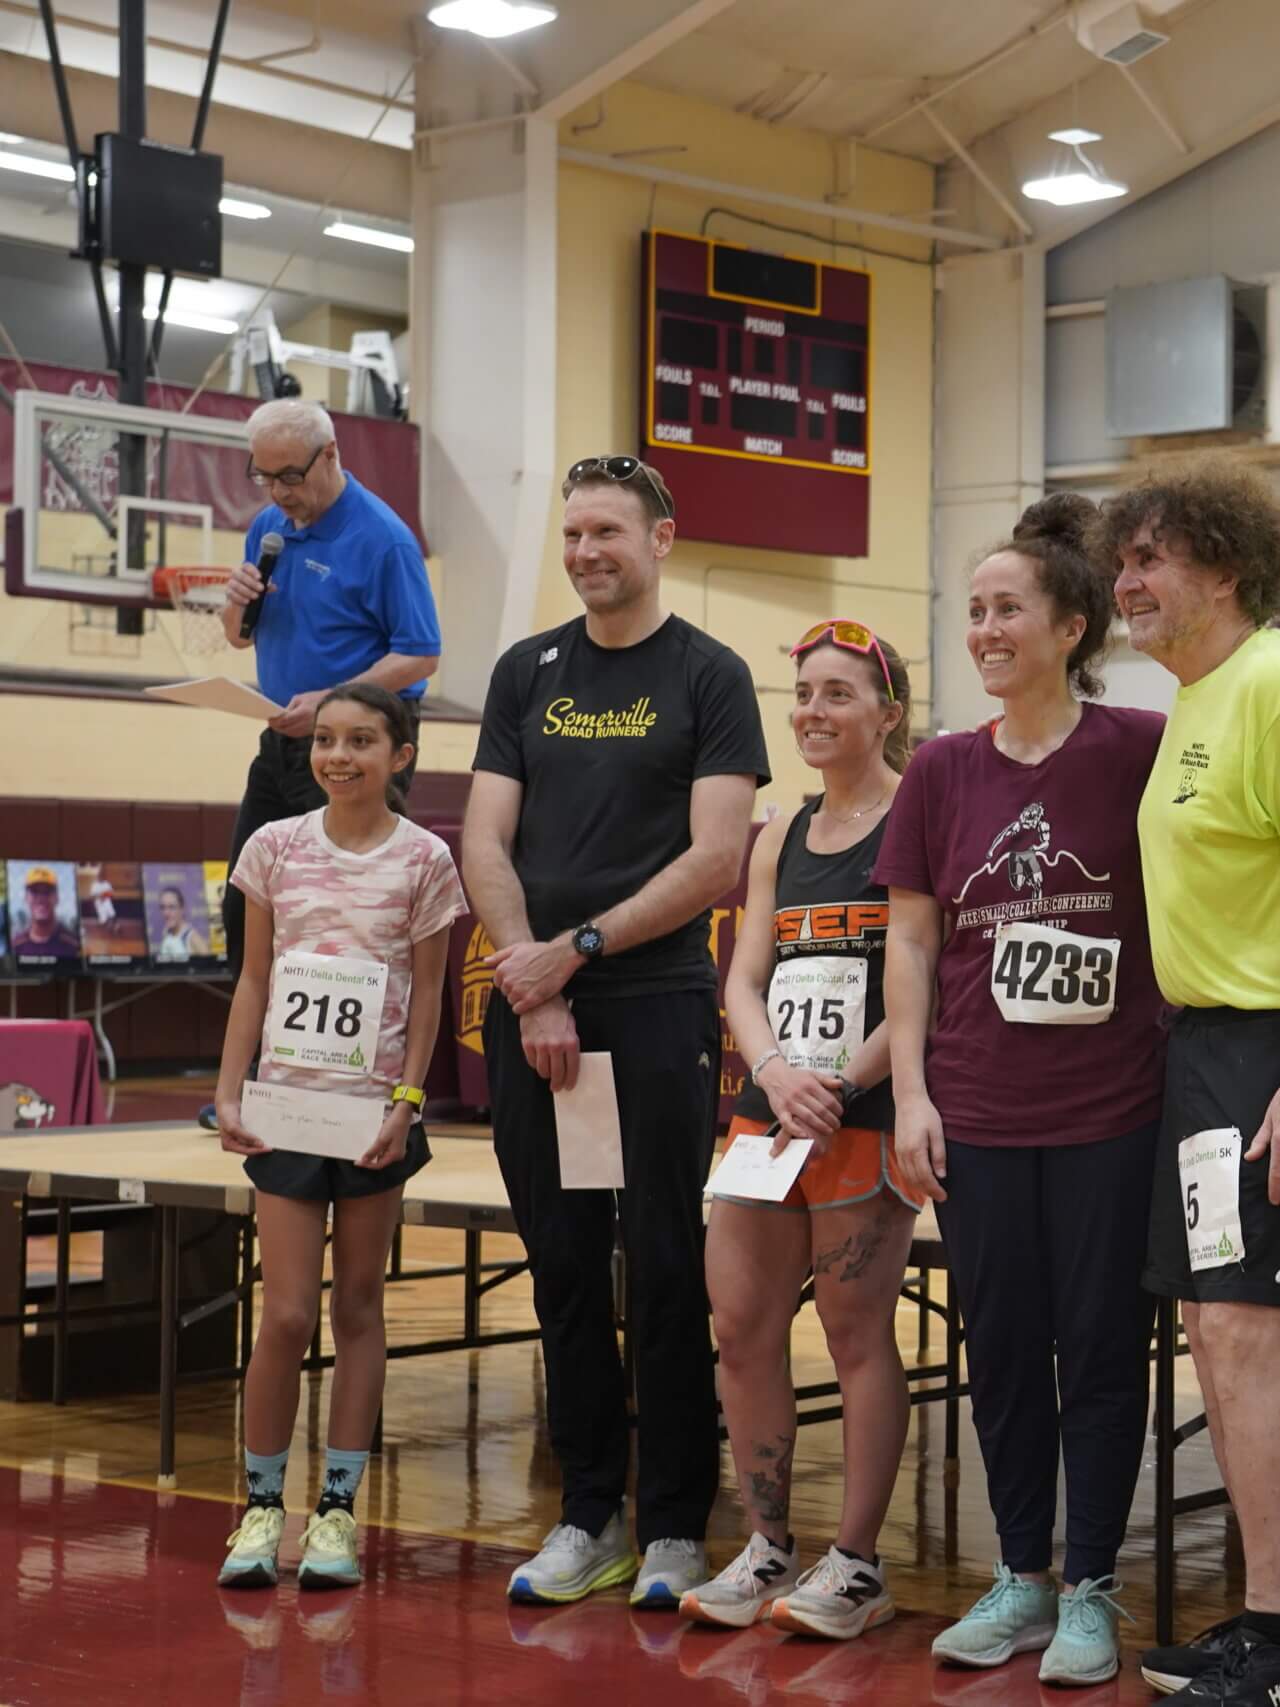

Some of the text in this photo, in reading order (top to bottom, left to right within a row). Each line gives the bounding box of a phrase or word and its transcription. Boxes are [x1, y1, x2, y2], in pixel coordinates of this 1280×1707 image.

[744, 316, 785, 337] PERIOD
[656, 365, 692, 386] FOULS
[729, 376, 800, 402] PLAYER FOUL
[831, 393, 866, 413] FOULS
[655, 423, 692, 443] SCORE
[744, 436, 783, 456] MATCH
[831, 448, 866, 467] SCORE
[543, 696, 657, 735] Somerville
[561, 725, 647, 739] ROAD RUNNERS
[980, 904, 1006, 923] SMALL
[1008, 899, 1049, 918] COLLEGE
[1052, 894, 1111, 911] CONFERENCE
[283, 965, 304, 977] NHTI
[335, 971, 365, 985] Dental
[367, 976, 379, 987] 5K
[847, 974, 860, 984] 5K
[994, 940, 1113, 1007] 4233
[283, 991, 363, 1038] 218
[778, 998, 845, 1041] 215
[1219, 1147, 1232, 1159] 5K
